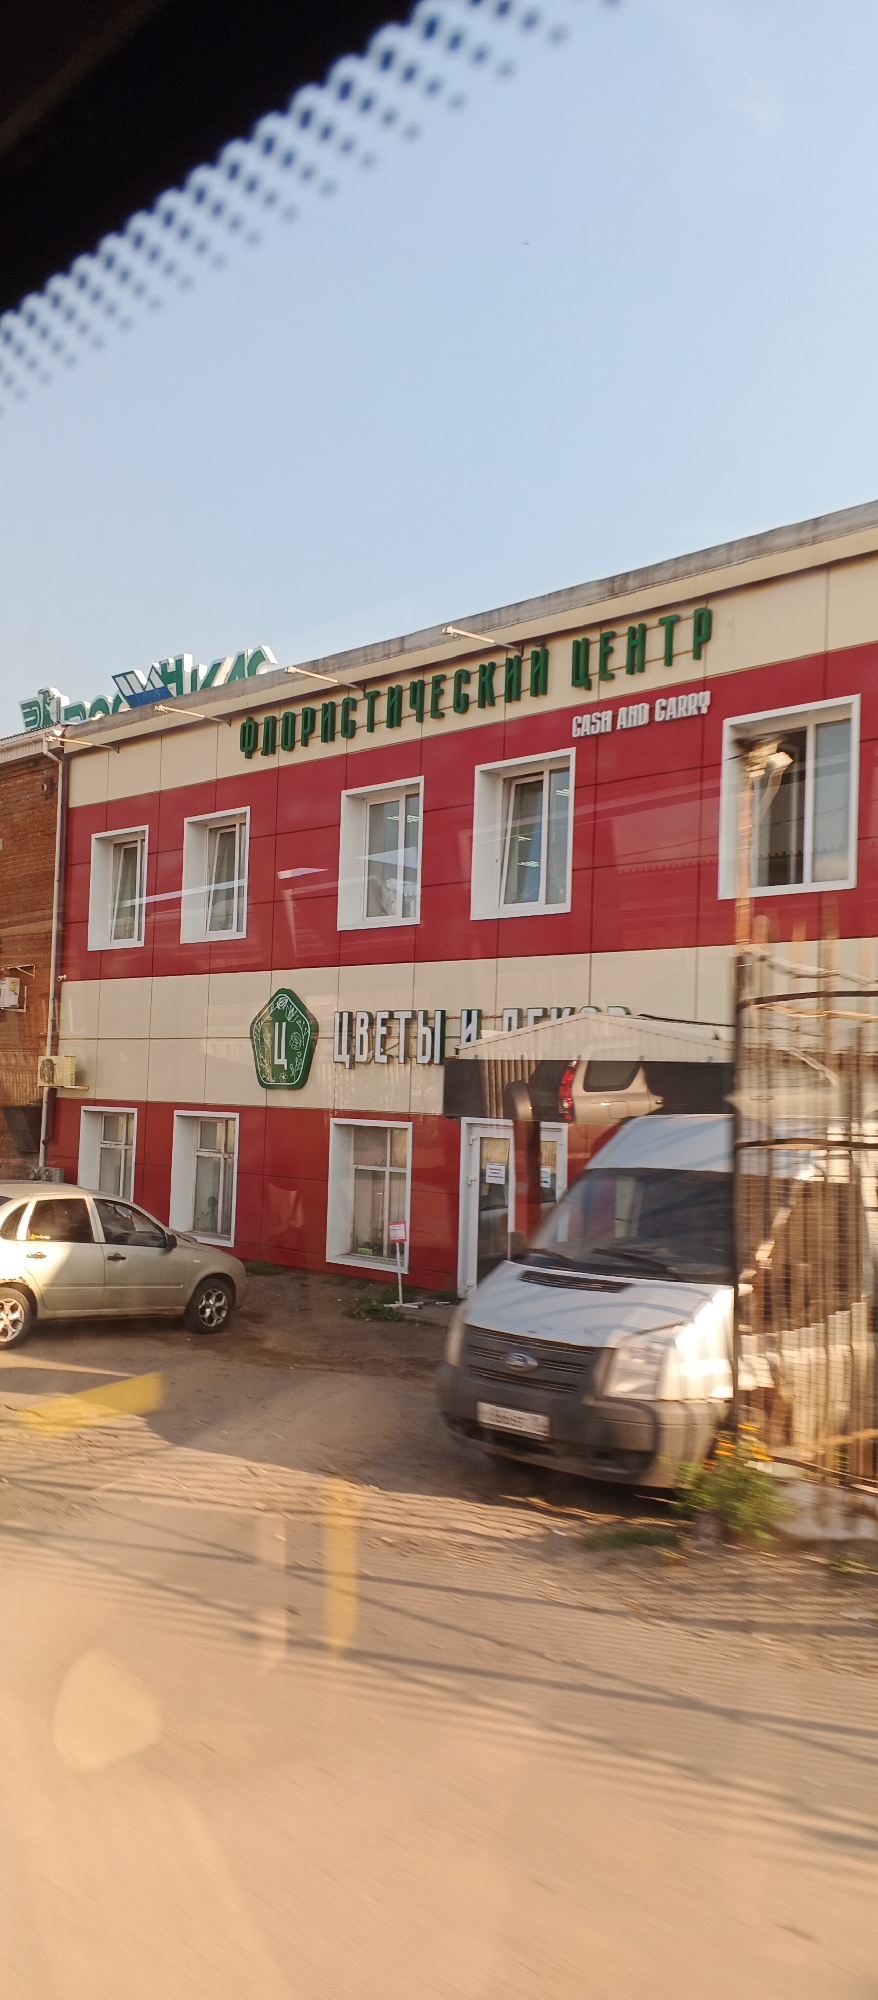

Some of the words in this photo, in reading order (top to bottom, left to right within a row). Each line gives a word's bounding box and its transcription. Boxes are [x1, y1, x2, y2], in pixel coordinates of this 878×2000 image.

[239, 642, 549, 760] ФЛОРИСТИЧЕСКИЙ
[571, 607, 712, 691] ЦЕНТР
[572, 710, 613, 738] CASH
[616, 703, 650, 730] AND
[654, 690, 711, 722] CARRY
[273, 1021, 288, 1070] Ц
[332, 1009, 446, 1069] ЦВЕТЫ
[460, 1008, 483, 1047] И
